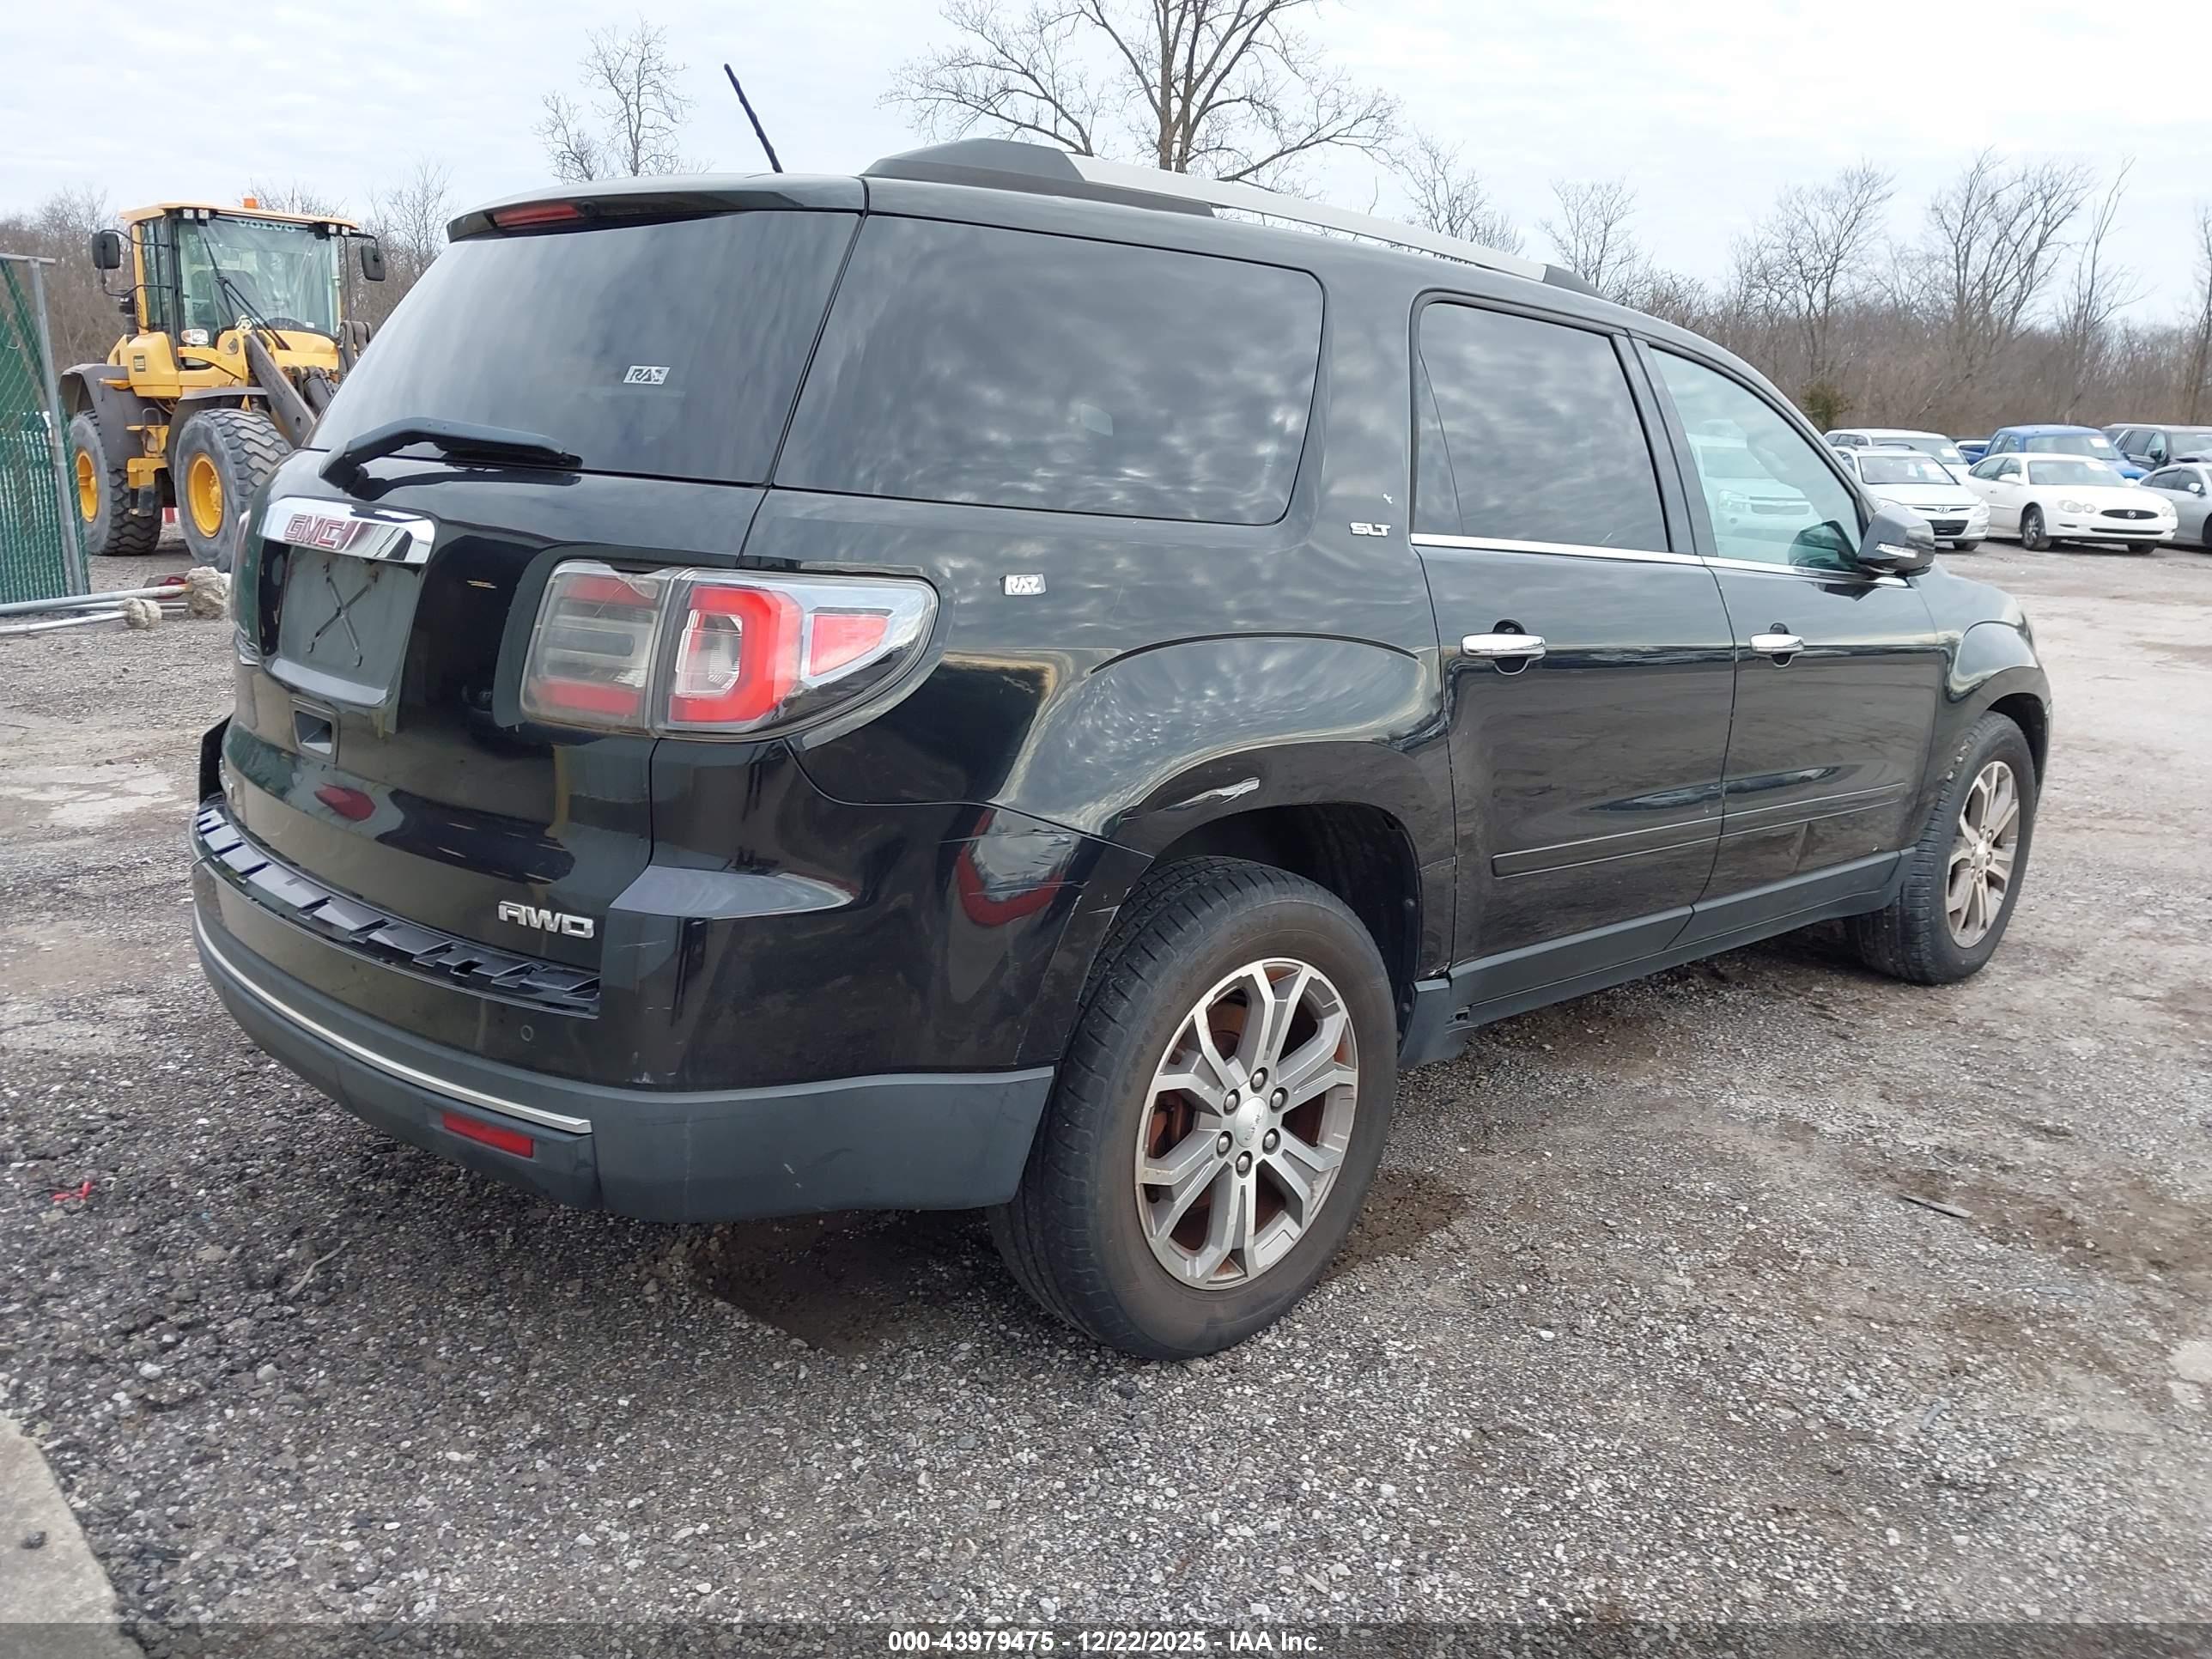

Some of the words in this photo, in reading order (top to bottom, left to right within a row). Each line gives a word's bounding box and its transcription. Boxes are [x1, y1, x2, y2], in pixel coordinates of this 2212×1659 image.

[234, 218, 296, 234] VOLVO
[284, 514, 346, 550] GMC
[1350, 521, 1391, 537] SLT
[498, 900, 594, 939] AWD
